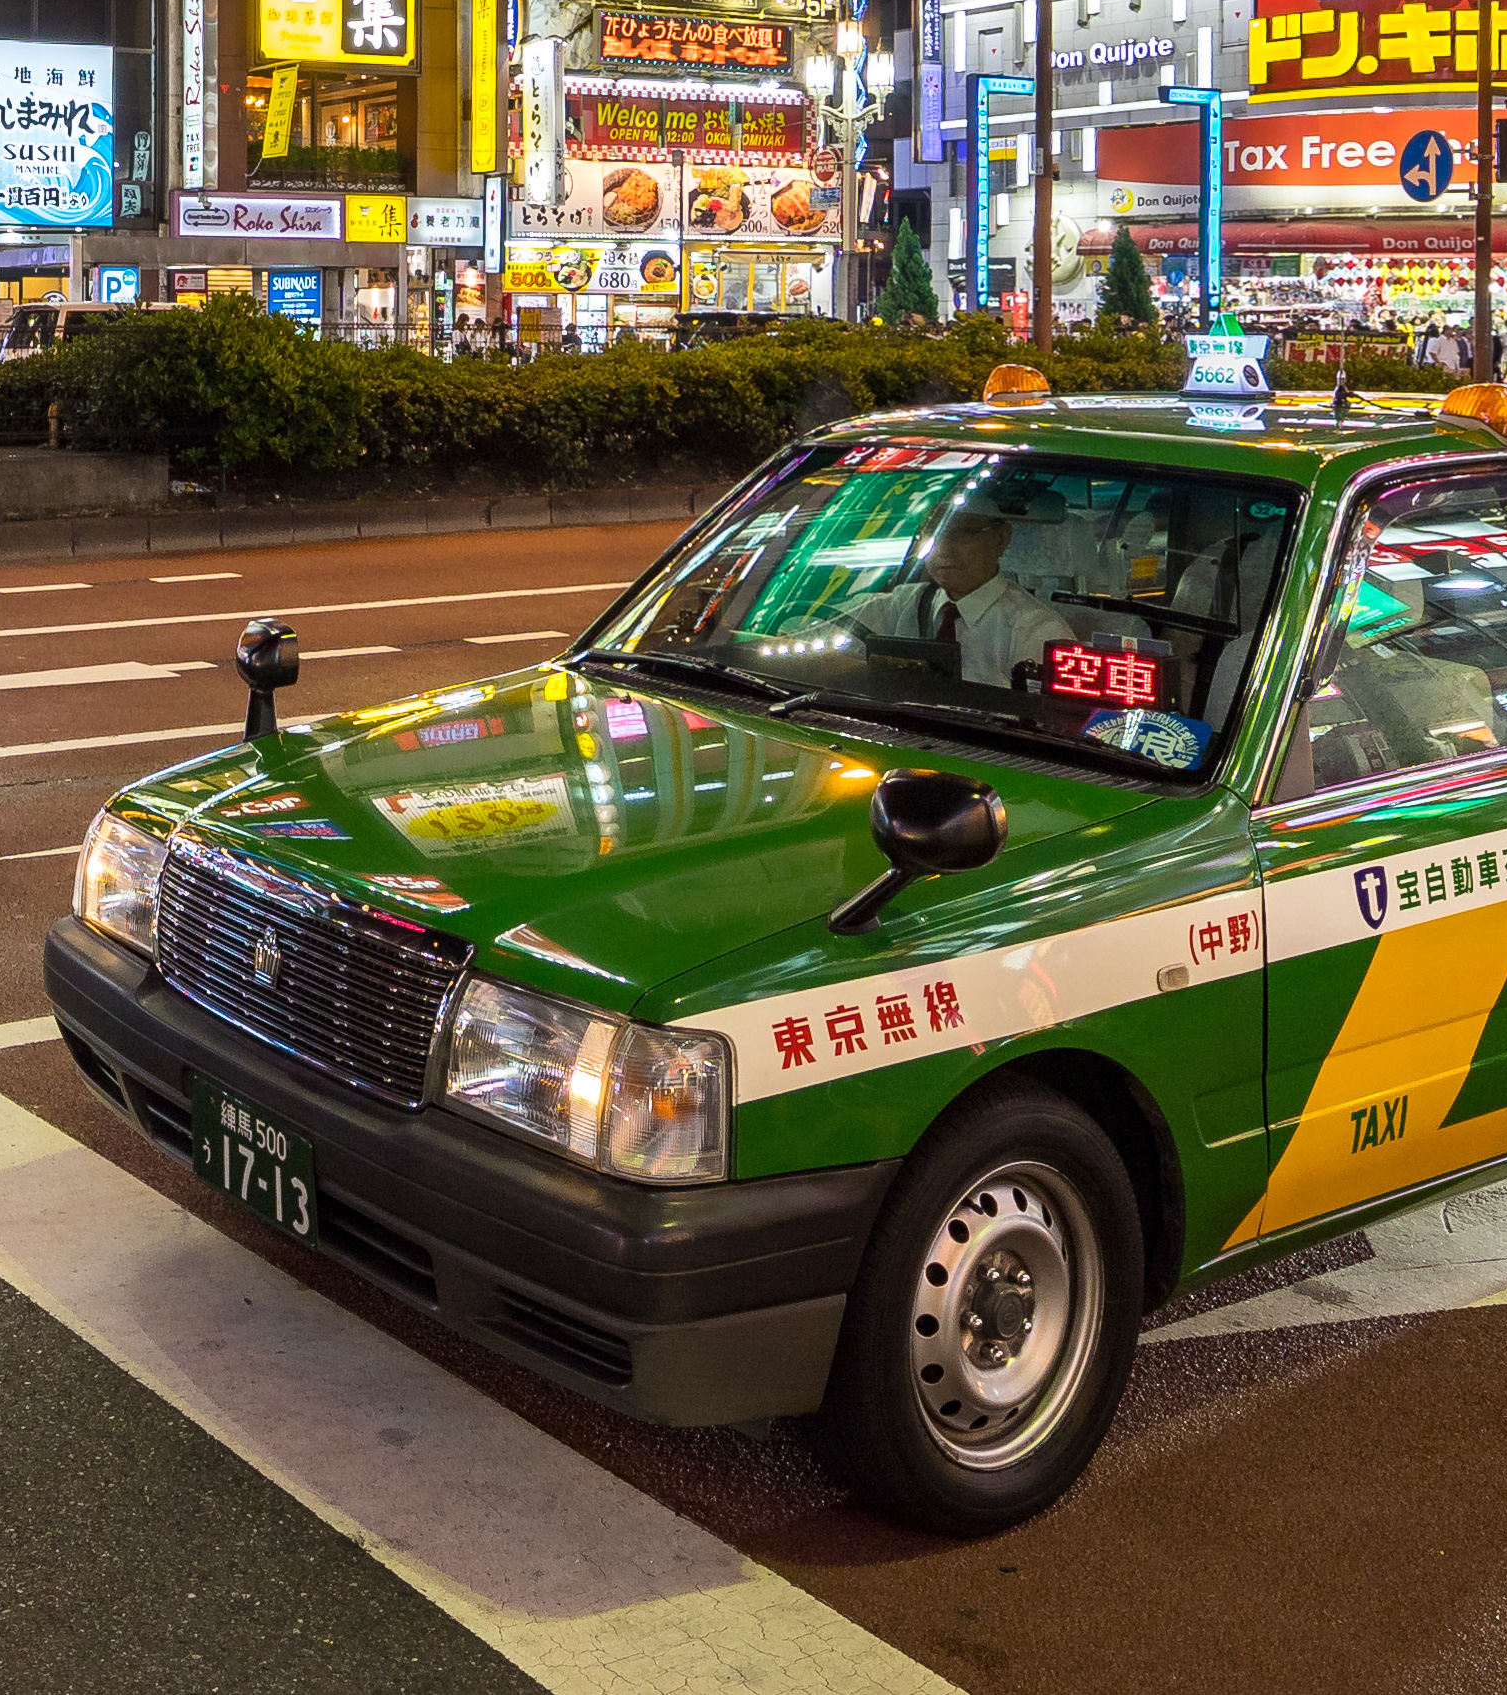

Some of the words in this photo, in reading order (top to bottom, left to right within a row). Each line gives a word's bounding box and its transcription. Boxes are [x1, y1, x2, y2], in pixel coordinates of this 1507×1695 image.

[604, 16, 783, 49] 7Fひょうたんの食べ放題!
[1089, 36, 1175, 66] Quijote
[609, 128, 641, 142] OPEN
[667, 130, 695, 143] 12:00
[3, 143, 76, 164] SUSHI
[1224, 139, 1288, 173] Tax
[1301, 135, 1396, 169] Free
[522, 206, 583, 227] とらそば
[1137, 196, 1161, 208] Don
[233, 205, 274, 231] Roko
[280, 206, 322, 233] Shira
[379, 204, 403, 237] 集
[425, 214, 480, 230] 養老乃瀧
[272, 276, 317, 292] SUBNADE
[1194, 366, 1235, 384] 5662
[1053, 646, 1156, 705] 空車
[1188, 909, 1260, 965] (中野)
[771, 980, 966, 1071] 東京無線
[220, 1098, 253, 1142] 練馬
[256, 1116, 287, 1162] 500
[1351, 1095, 1409, 1153] TAXI
[223, 1133, 310, 1235] 17-13
